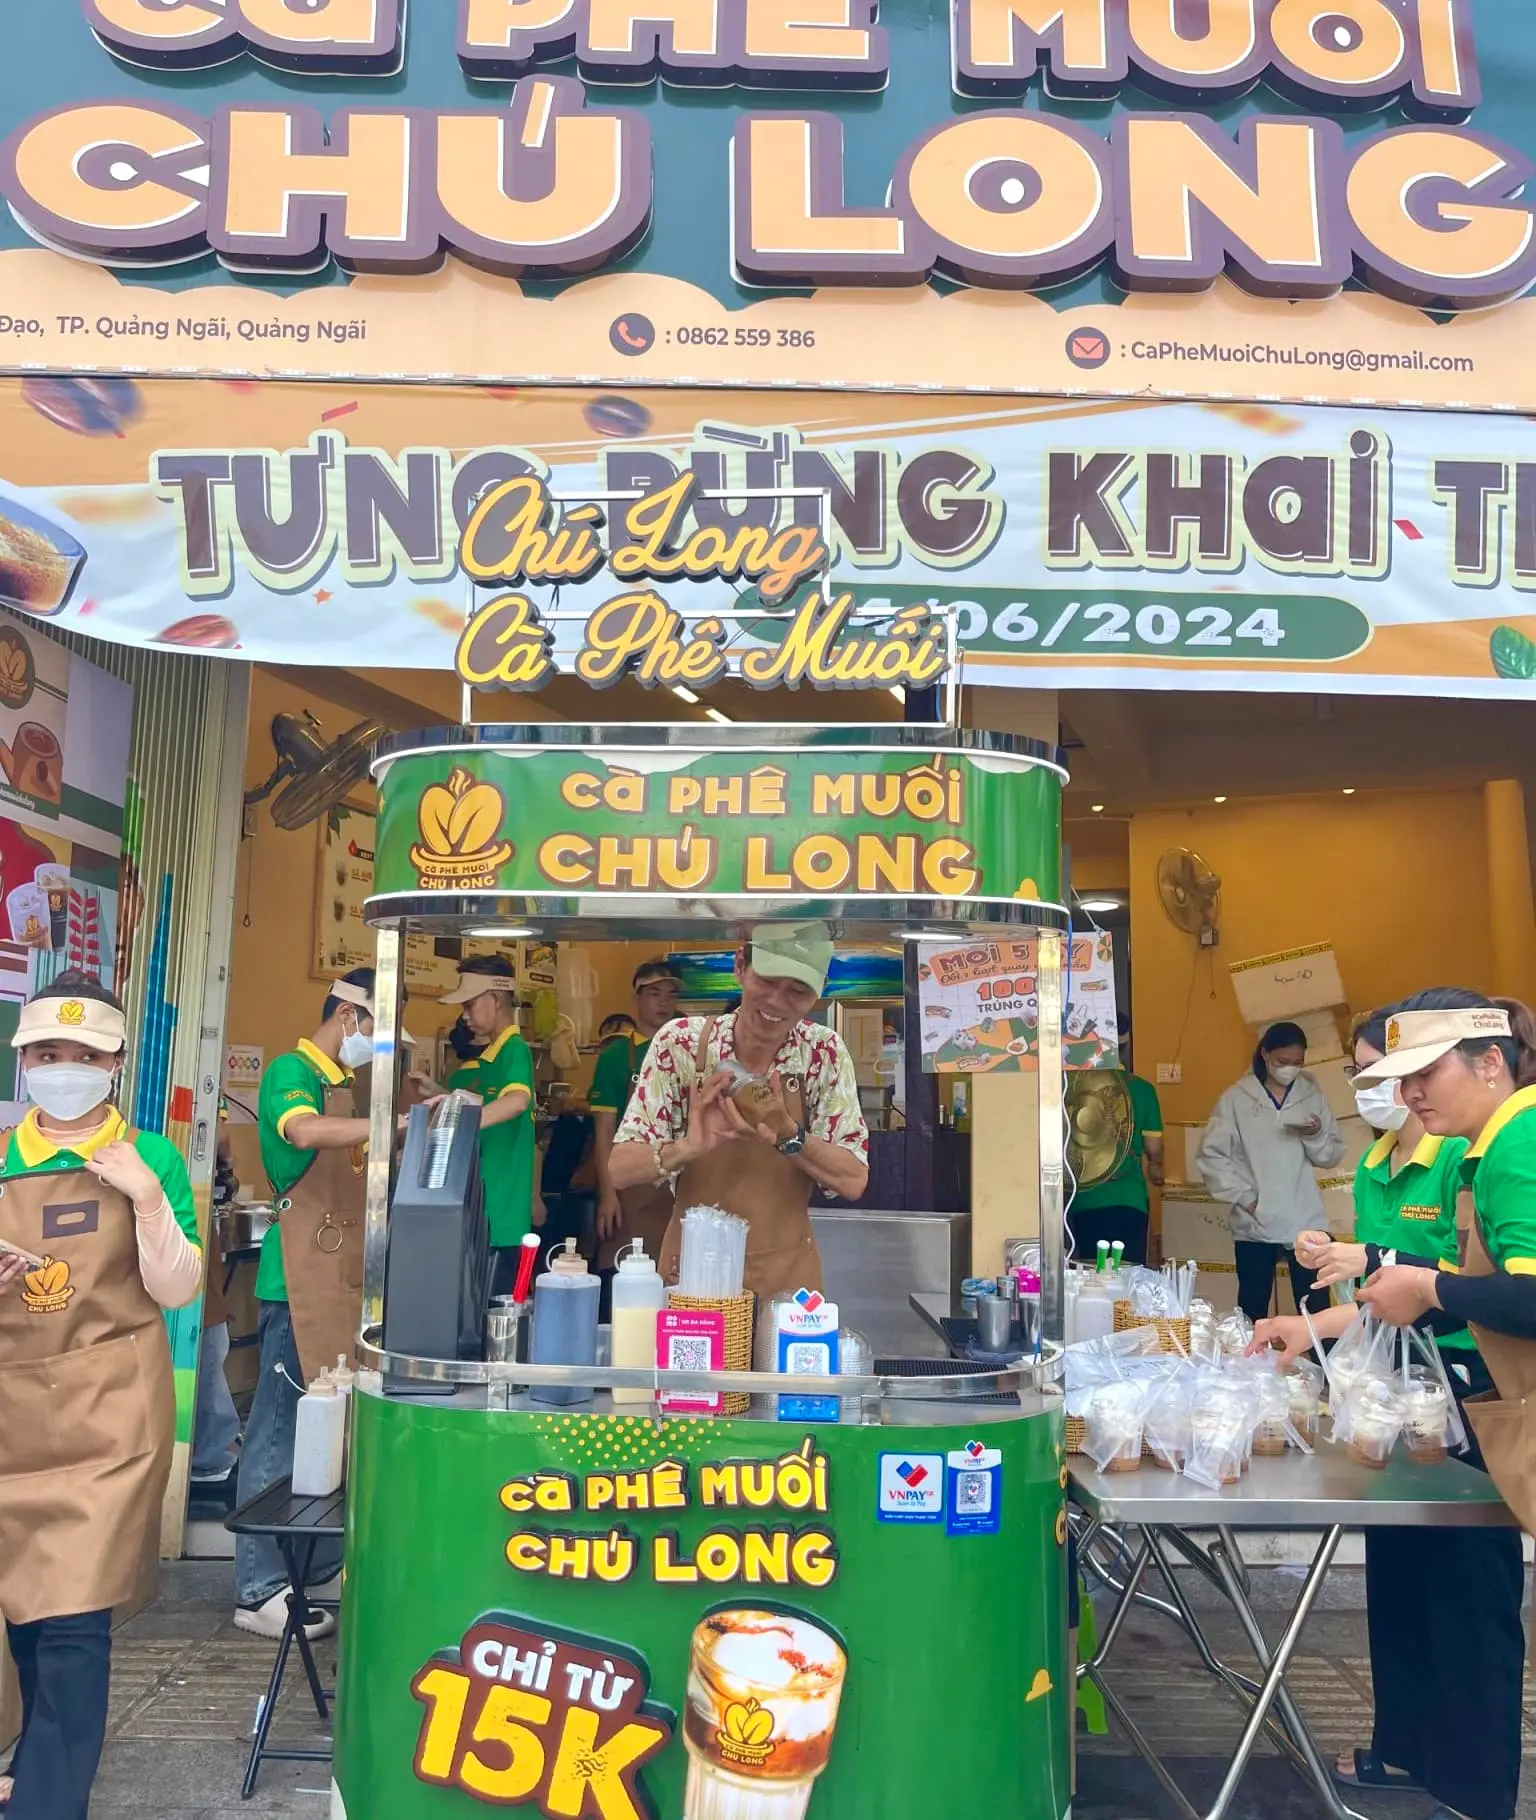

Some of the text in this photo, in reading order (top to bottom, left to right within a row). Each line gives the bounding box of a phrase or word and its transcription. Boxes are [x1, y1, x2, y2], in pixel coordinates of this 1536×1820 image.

[10, 79, 1536, 290] CHÚ LONG
[56, 316, 90, 334] TP.
[96, 315, 170, 340] Quảng
[176, 316, 232, 341] Ngãi,
[237, 317, 311, 342] Quảng
[317, 319, 367, 343] Ngãi
[676, 327, 729, 346] 0862
[734, 328, 771, 347] 559
[776, 329, 816, 348] 386
[1130, 340, 1475, 372] CaPheMuoiChuLong@gmail.com
[459, 469, 828, 598] Chú Long
[455, 590, 947, 684] Cà Phê Muối
[668, 764, 786, 814] PHÊ
[451, 875, 495, 890] LONG
[538, 825, 977, 896] CHÚ LONG
[976, 999, 1024, 1013] TRÚNG
[585, 1460, 687, 1510] PHÊ
[504, 1529, 836, 1588] CHÚ LONG
[472, 1638, 635, 1711] CHỈ TỪ
[417, 1668, 664, 1820] 15K
